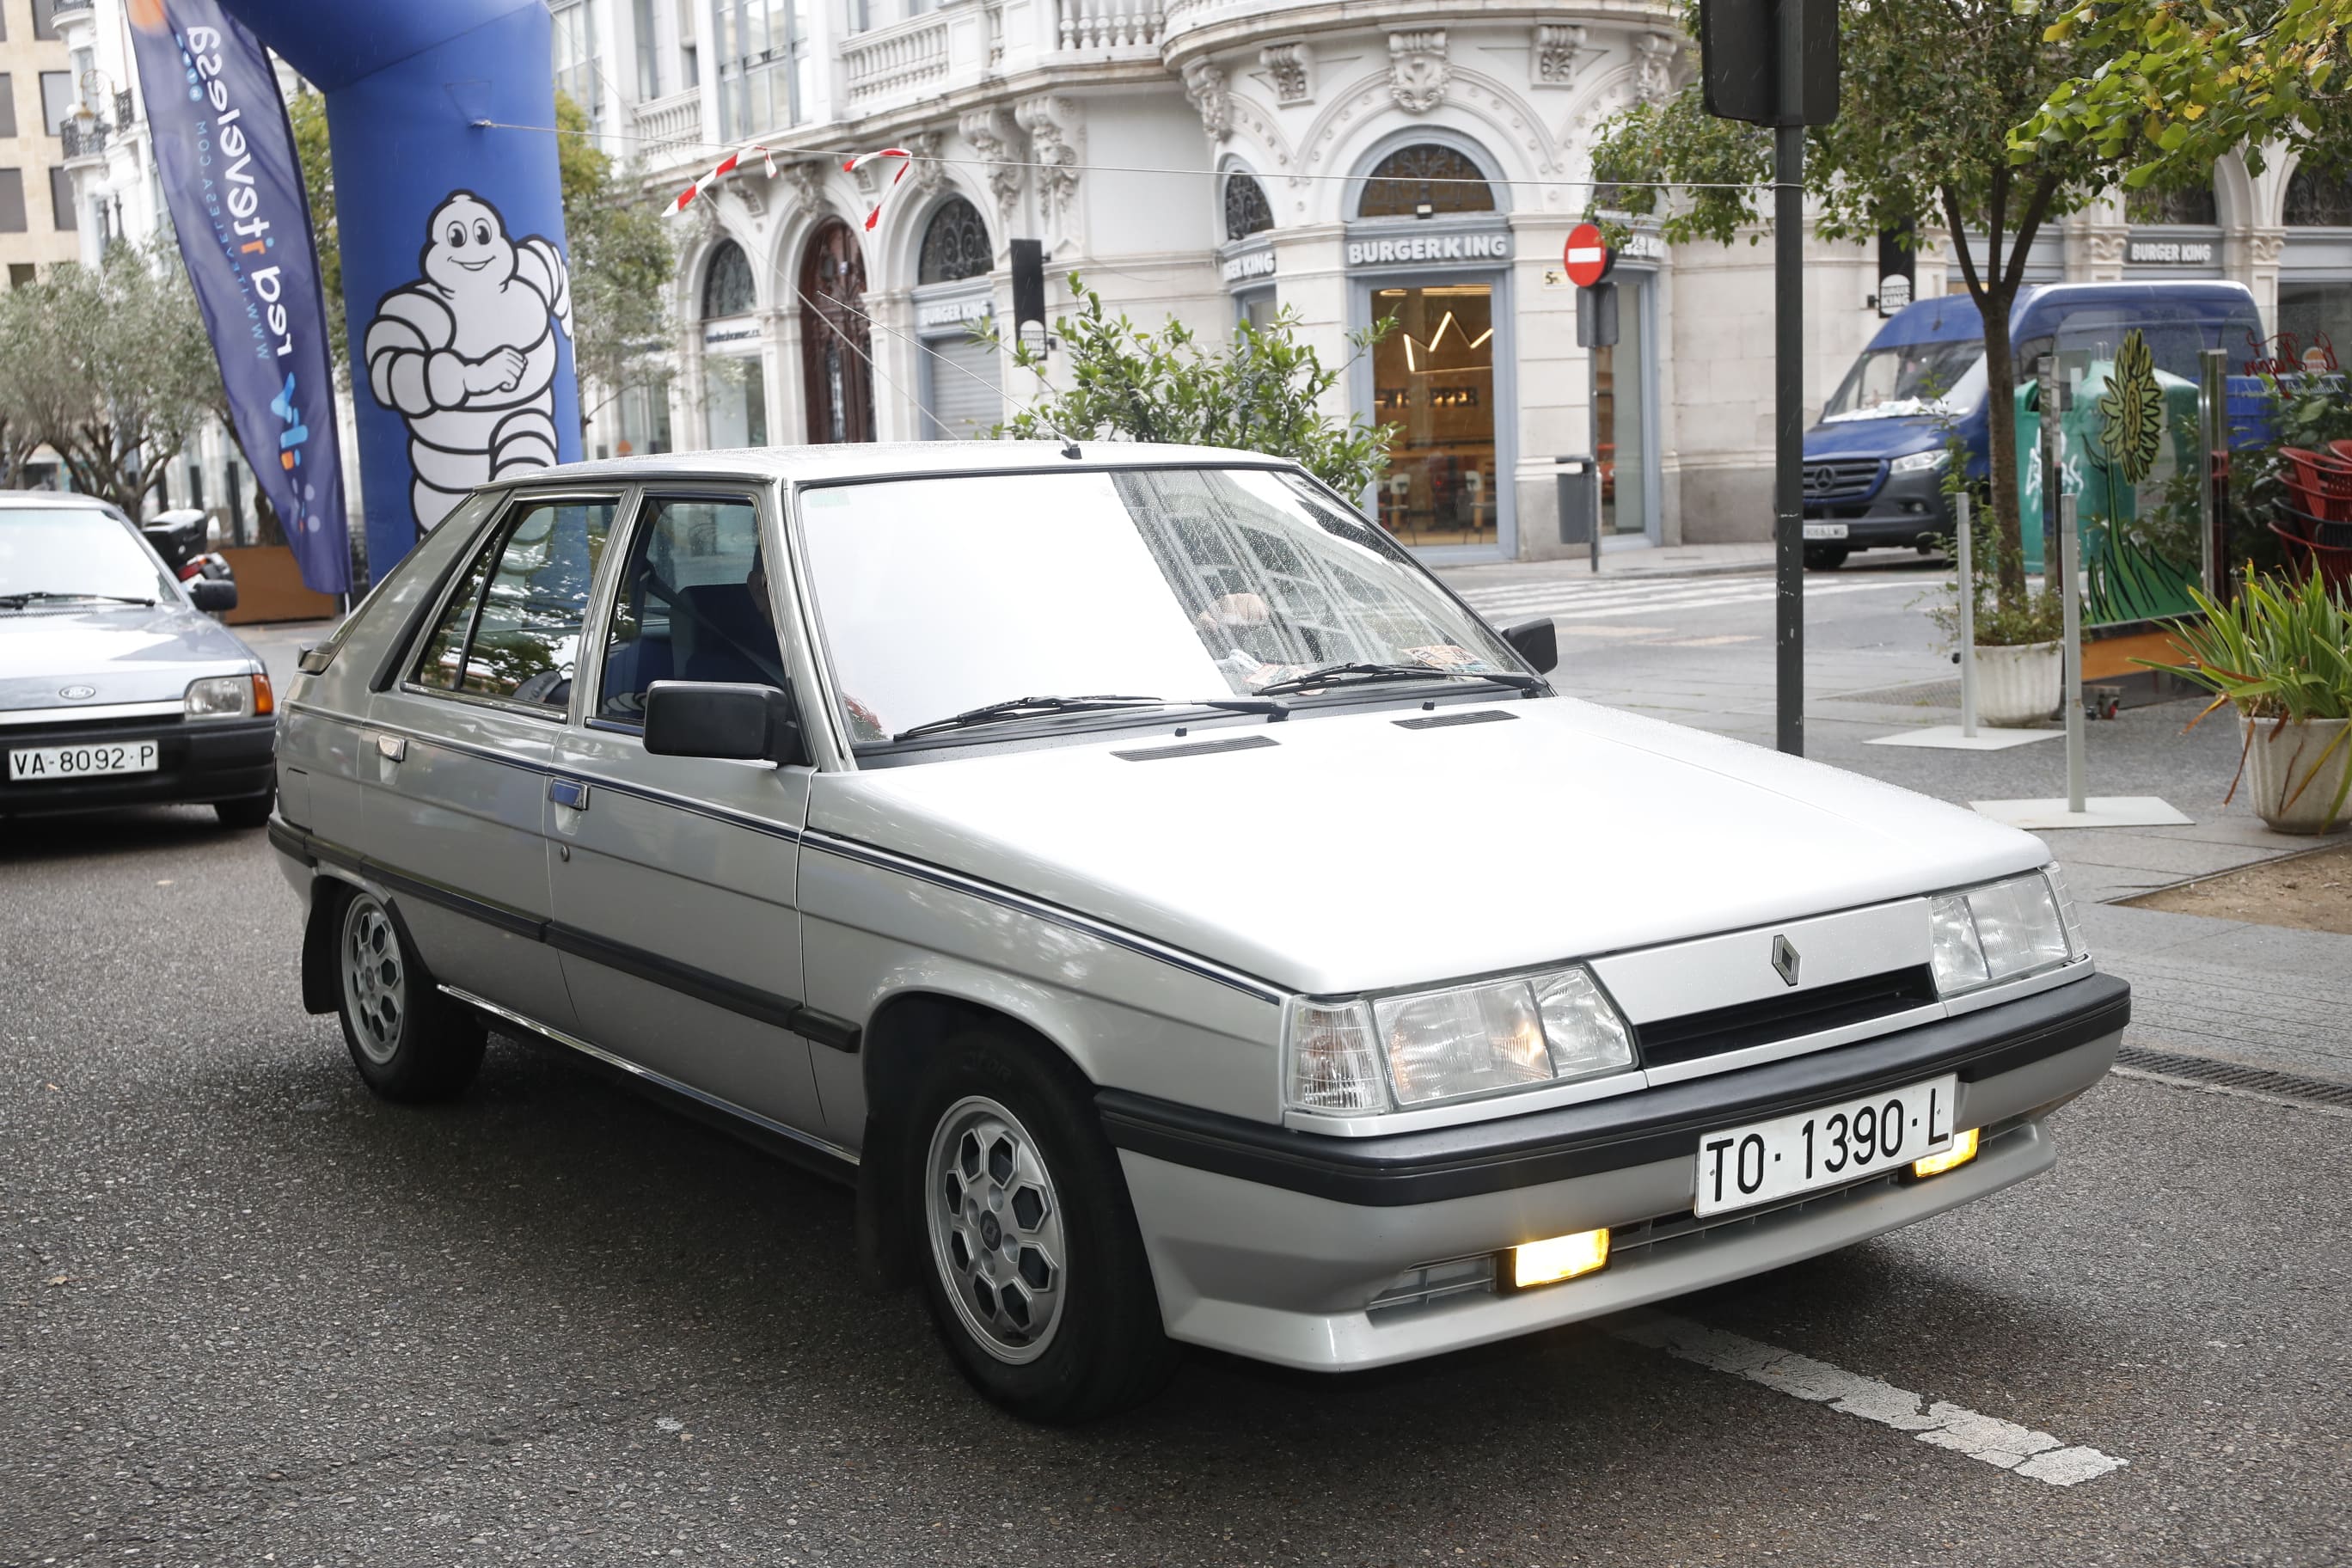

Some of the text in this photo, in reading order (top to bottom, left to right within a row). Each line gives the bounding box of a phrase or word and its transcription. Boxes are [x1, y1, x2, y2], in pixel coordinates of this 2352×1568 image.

[1349, 235, 1508, 265] BURGER KING
[2131, 242, 2212, 261] BURGER KING
[1242, 252, 1275, 276] KING
[961, 299, 989, 321] KING
